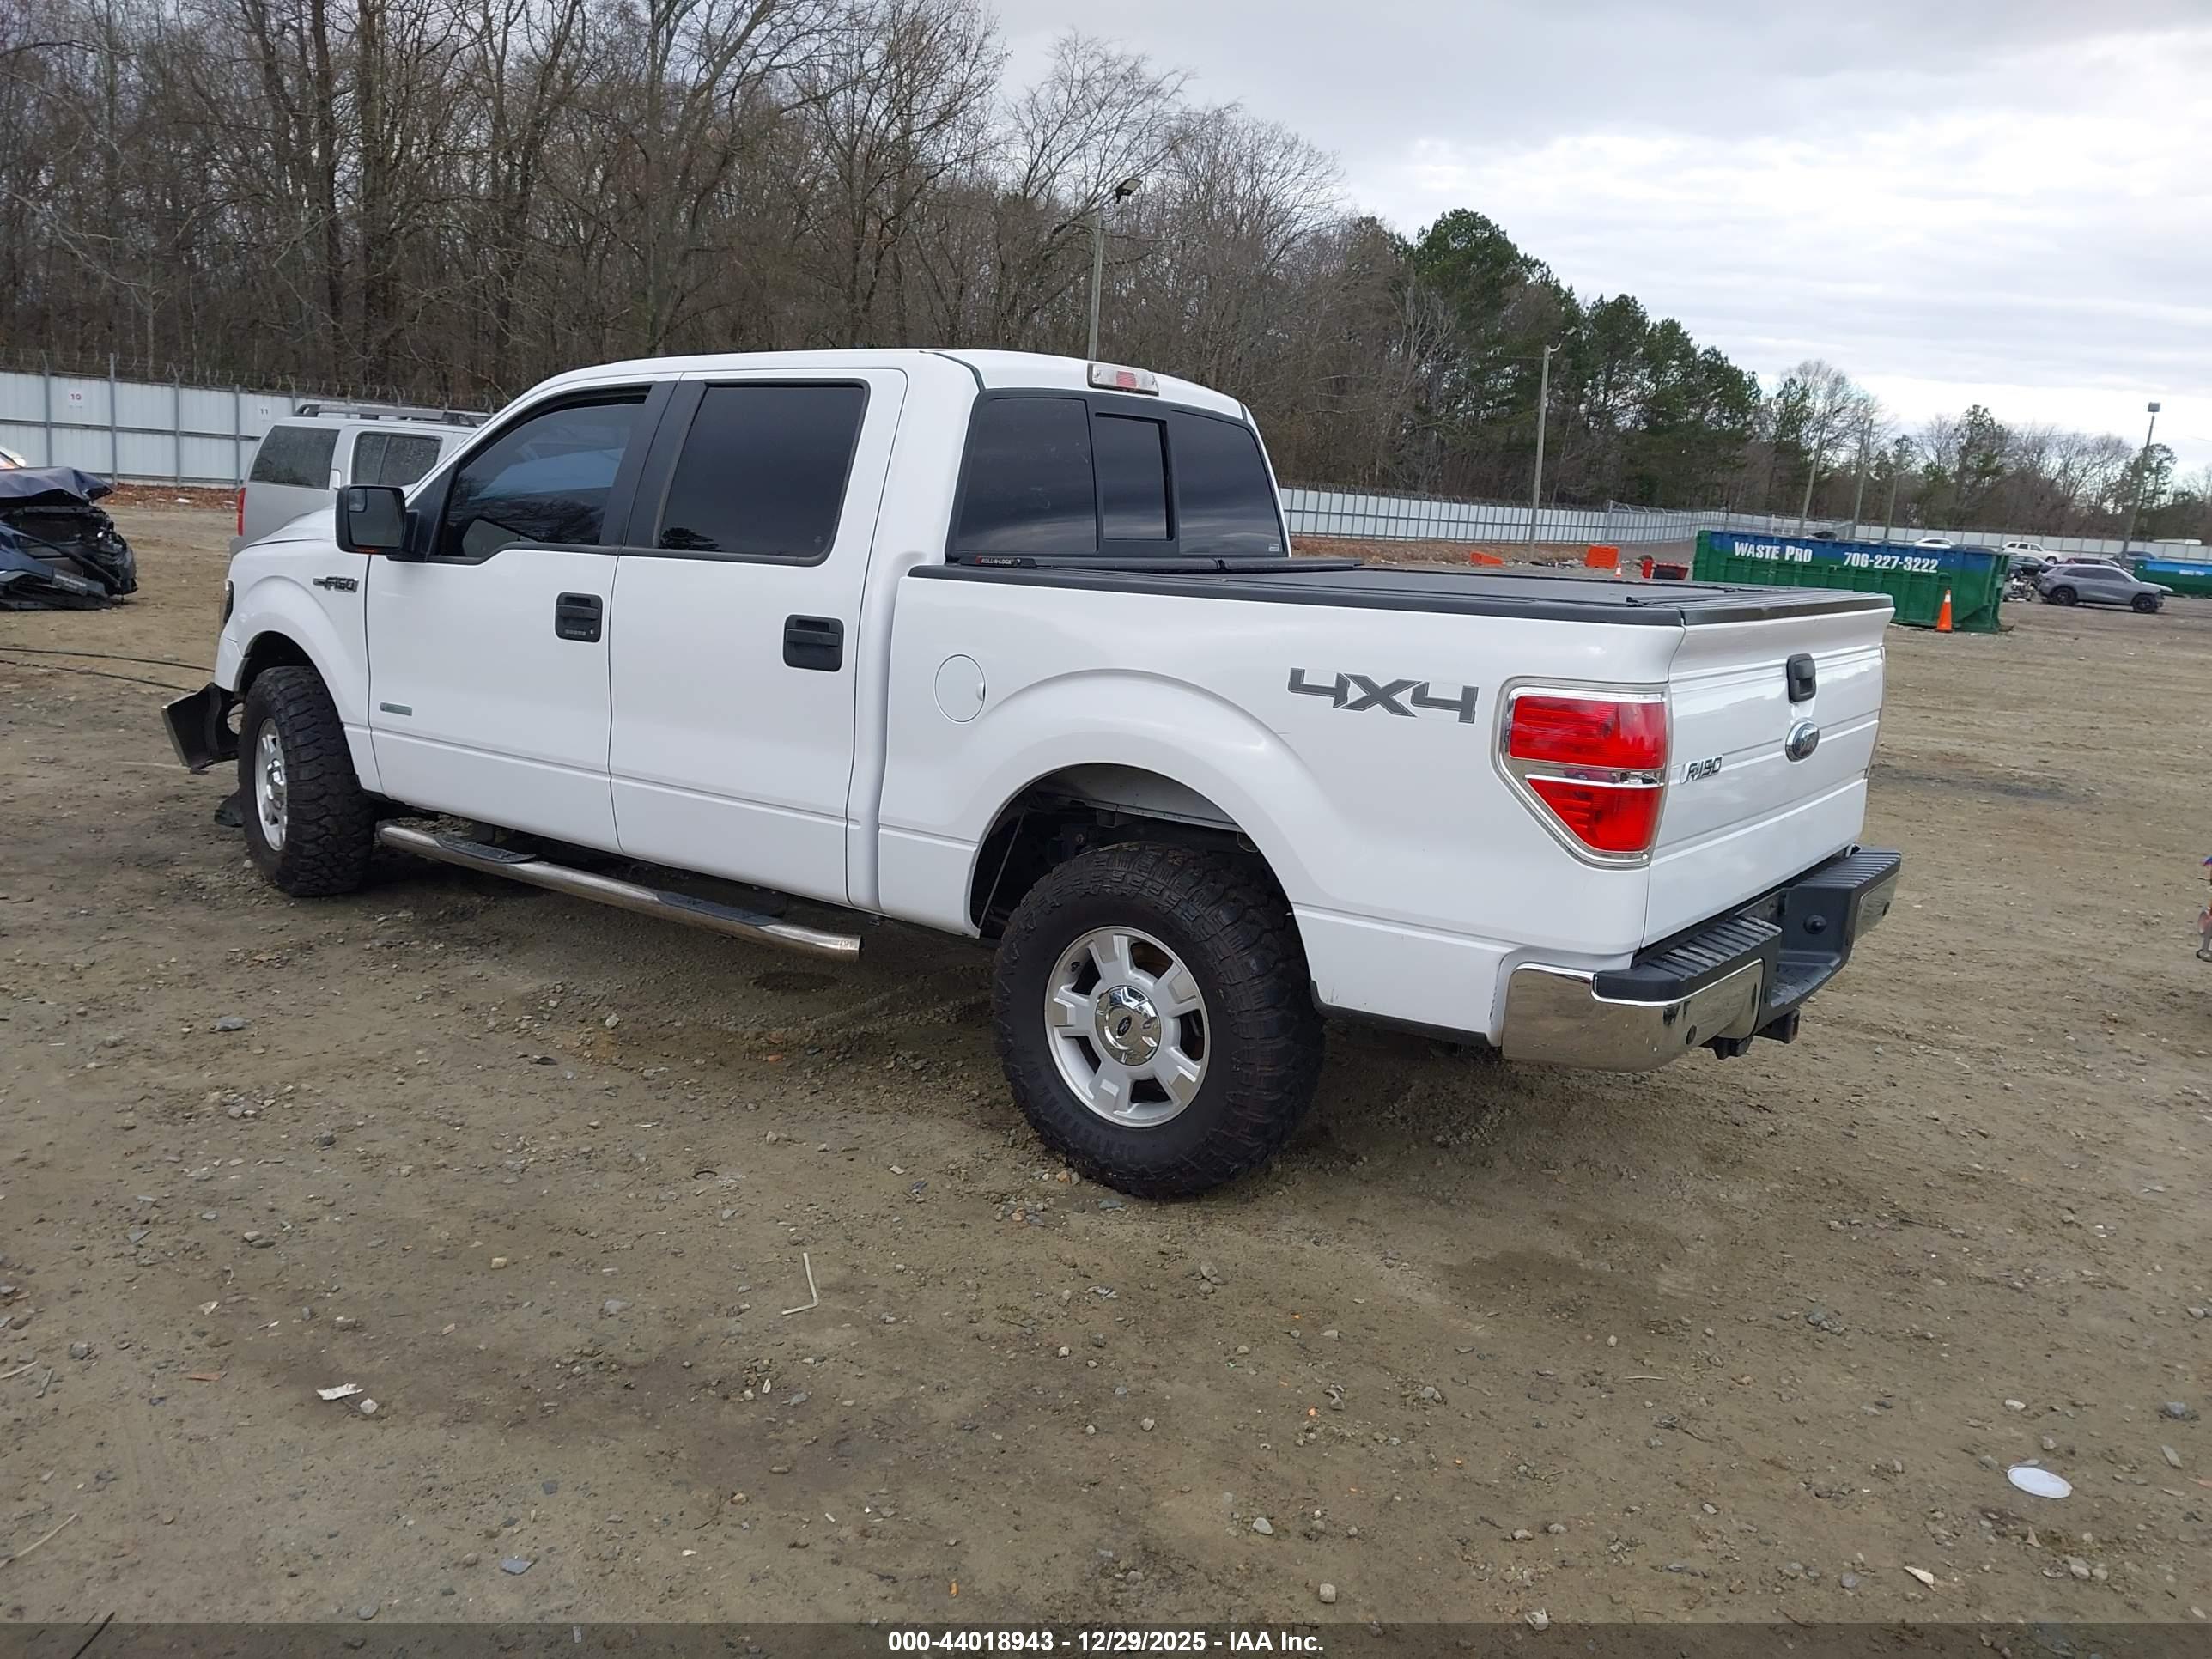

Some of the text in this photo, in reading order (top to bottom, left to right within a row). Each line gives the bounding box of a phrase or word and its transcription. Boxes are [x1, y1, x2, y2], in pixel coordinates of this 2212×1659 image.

[1734, 541, 1813, 563] WASTE PRO
[1843, 551, 1939, 574] 706-227-3222
